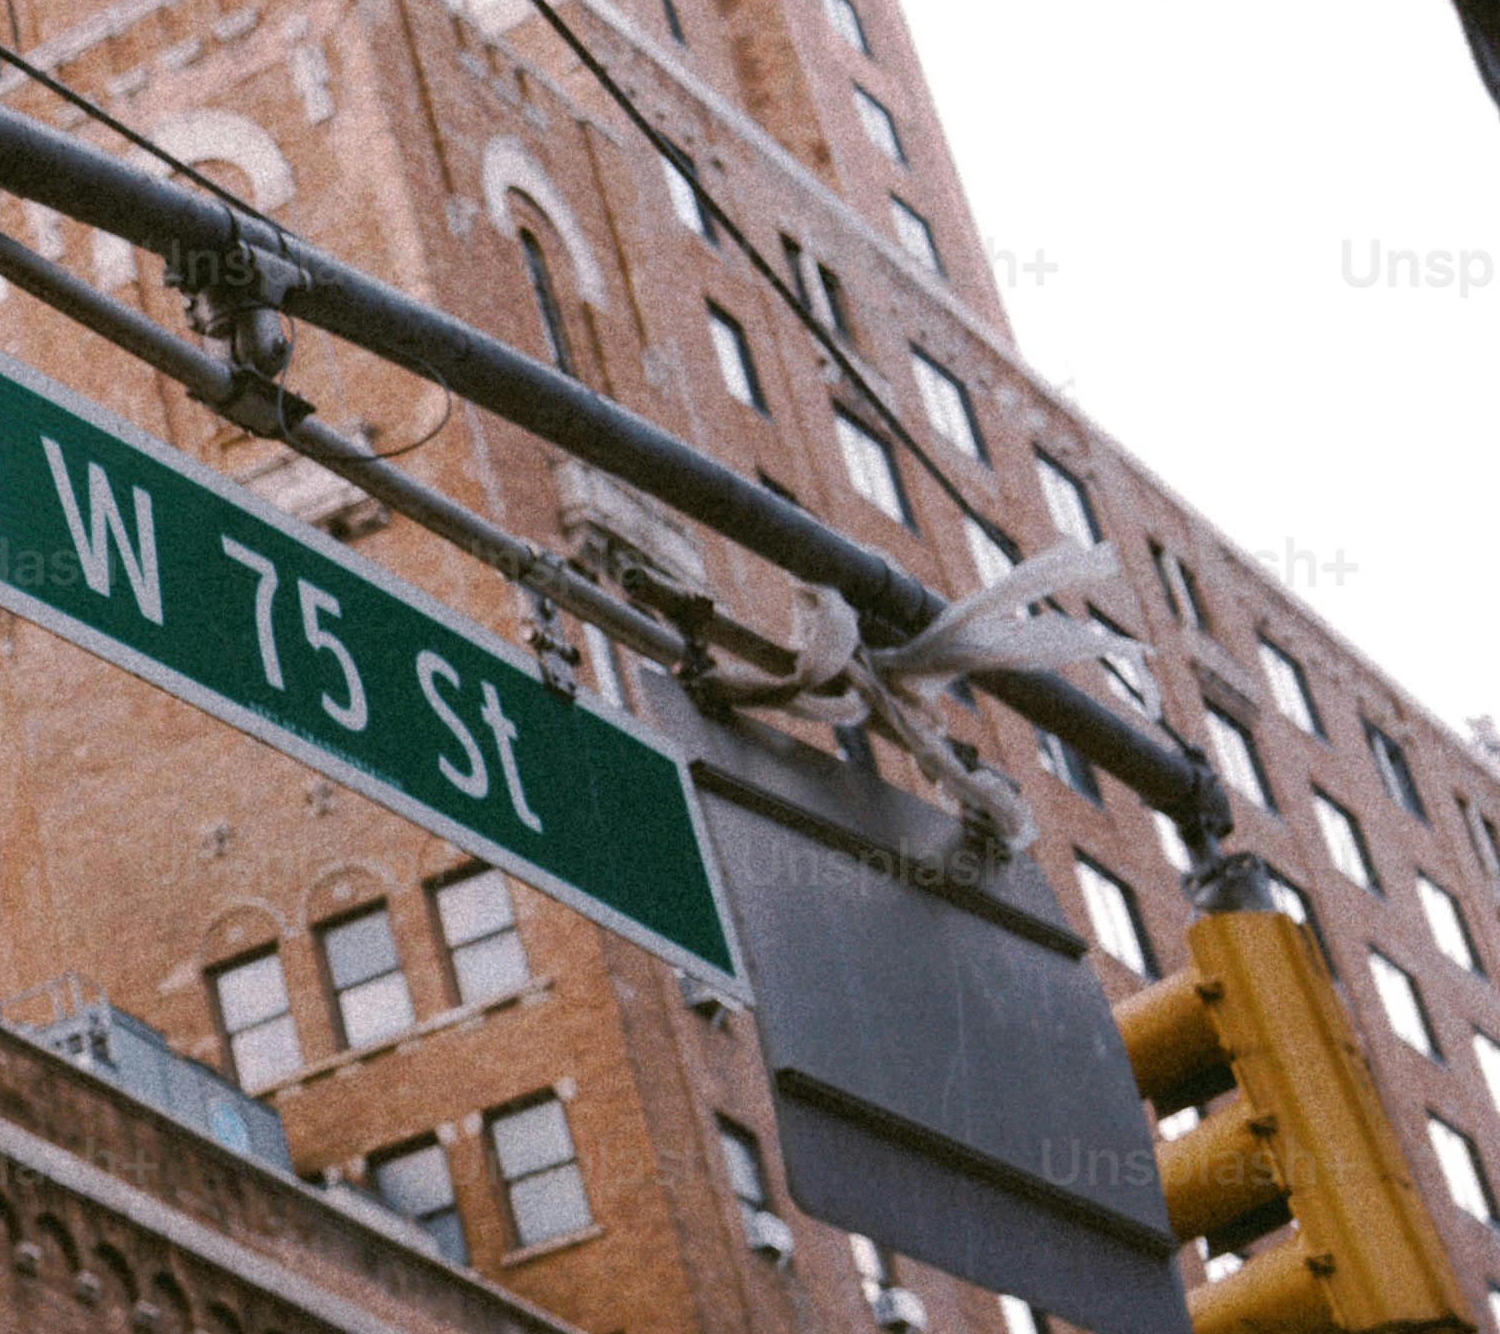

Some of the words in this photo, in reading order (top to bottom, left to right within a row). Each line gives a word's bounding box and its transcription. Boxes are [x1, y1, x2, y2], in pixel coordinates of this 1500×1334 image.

[39, 434, 163, 626] W
[220, 533, 368, 732] 75
[415, 648, 543, 835] St
